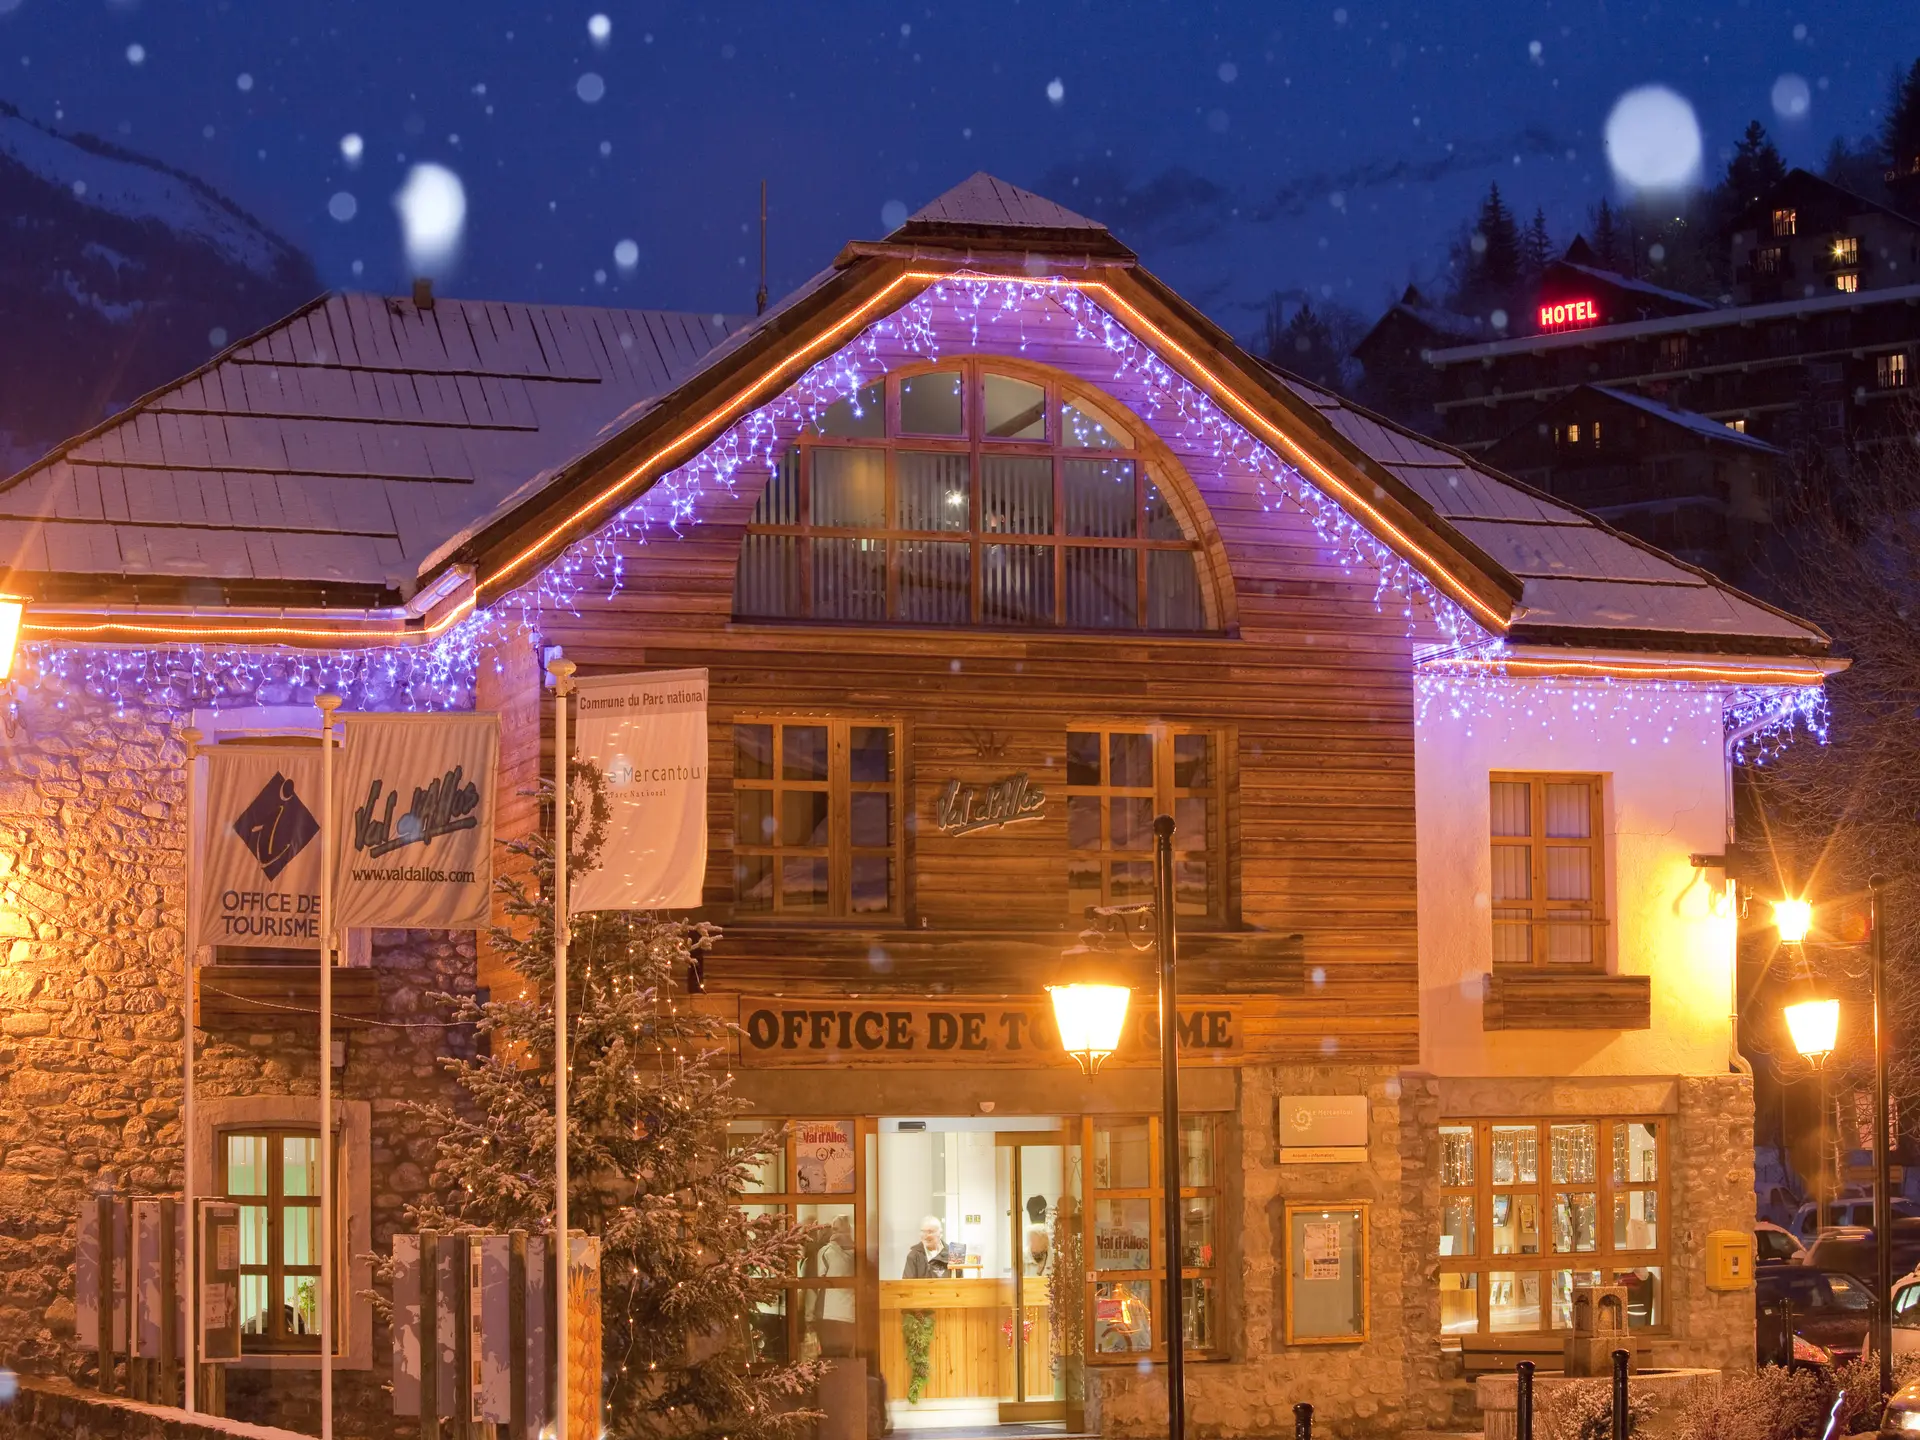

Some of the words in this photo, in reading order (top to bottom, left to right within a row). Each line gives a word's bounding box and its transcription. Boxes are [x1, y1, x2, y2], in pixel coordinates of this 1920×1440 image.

[1541, 300, 1597, 326] HOTEL
[580, 696, 625, 710] Commune
[628, 693, 640, 706] du
[643, 692, 664, 706] Parc
[667, 689, 706, 704] national
[630, 789, 666, 798] National
[352, 866, 476, 883] www.valdallos.com
[222, 890, 292, 913] OFFICE
[297, 894, 321, 914] DE
[221, 915, 320, 938] TOURISME
[747, 1009, 913, 1050] OFFICE
[927, 1011, 988, 1051] DE
[803, 1132, 818, 1144] Val
[819, 1131, 848, 1144] d'Allos
[1096, 1235, 1114, 1250] Val
[1115, 1235, 1149, 1250] d'Allos
